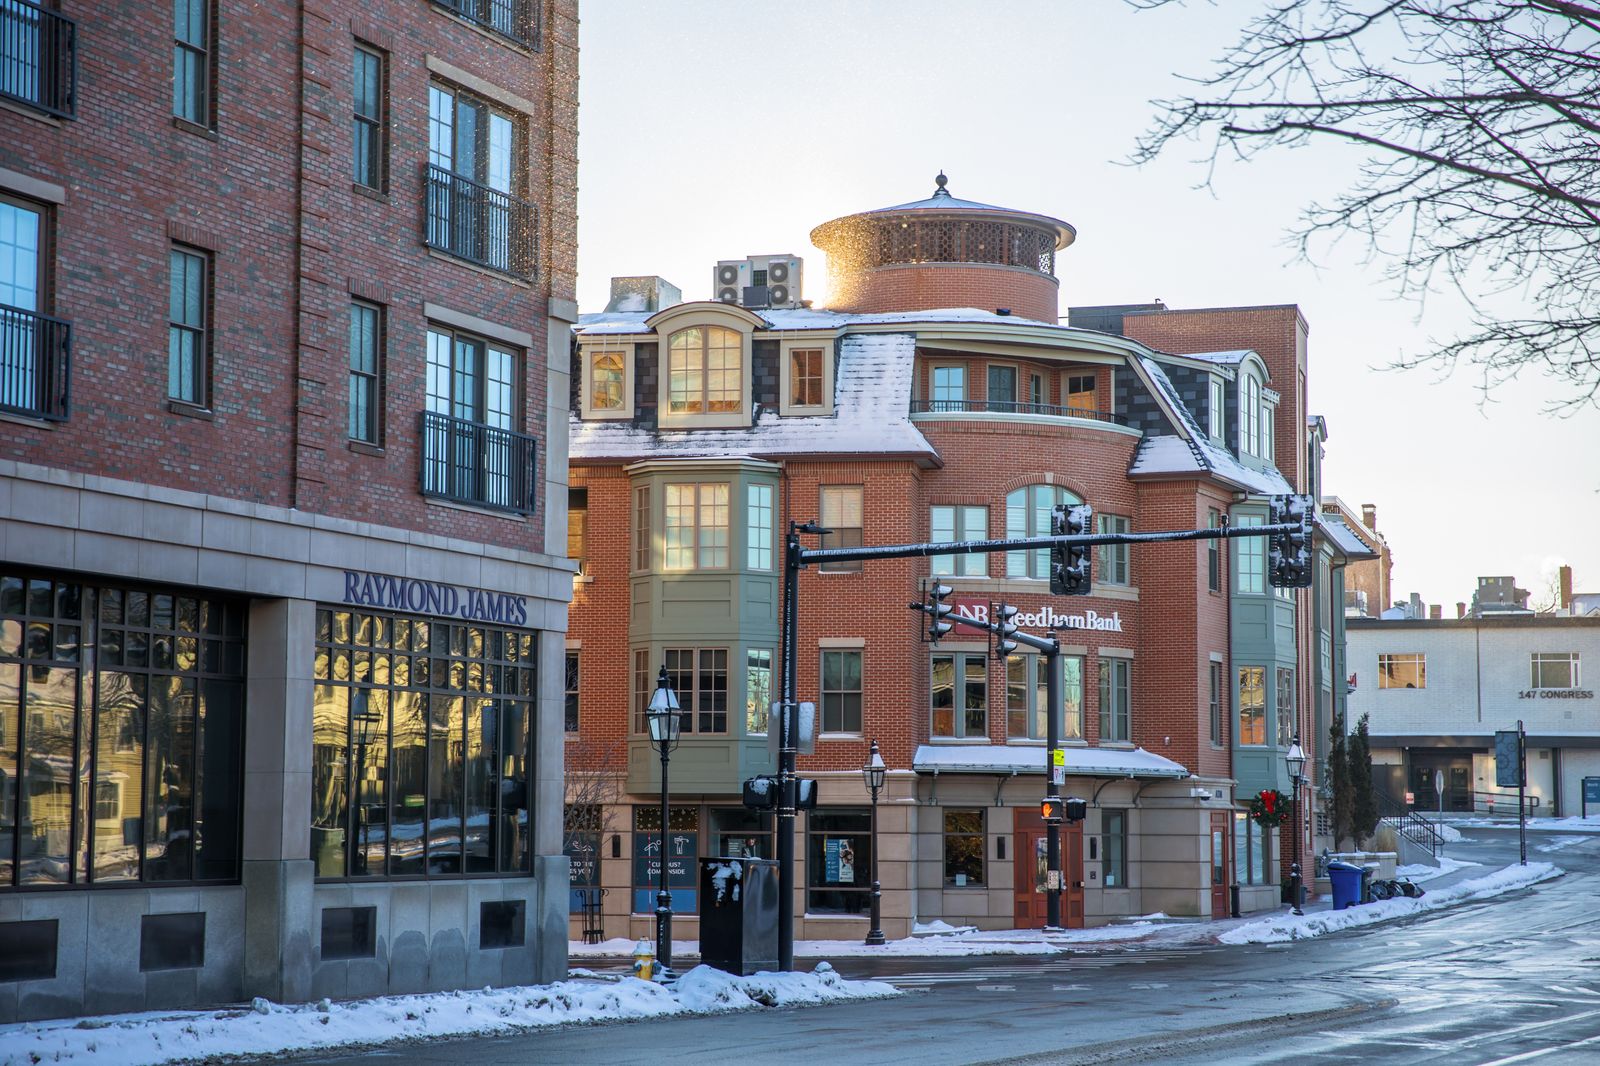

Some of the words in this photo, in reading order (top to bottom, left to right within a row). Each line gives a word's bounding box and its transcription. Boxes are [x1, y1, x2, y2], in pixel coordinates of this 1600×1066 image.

[343, 570, 459, 616] RAYMOND
[460, 588, 527, 626] JAMES
[958, 604, 989, 625] NB
[993, 605, 1086, 630] eedham
[1084, 610, 1123, 632] Bank
[1518, 690, 1537, 699] 147
[1540, 690, 1594, 699] CONGRESS
